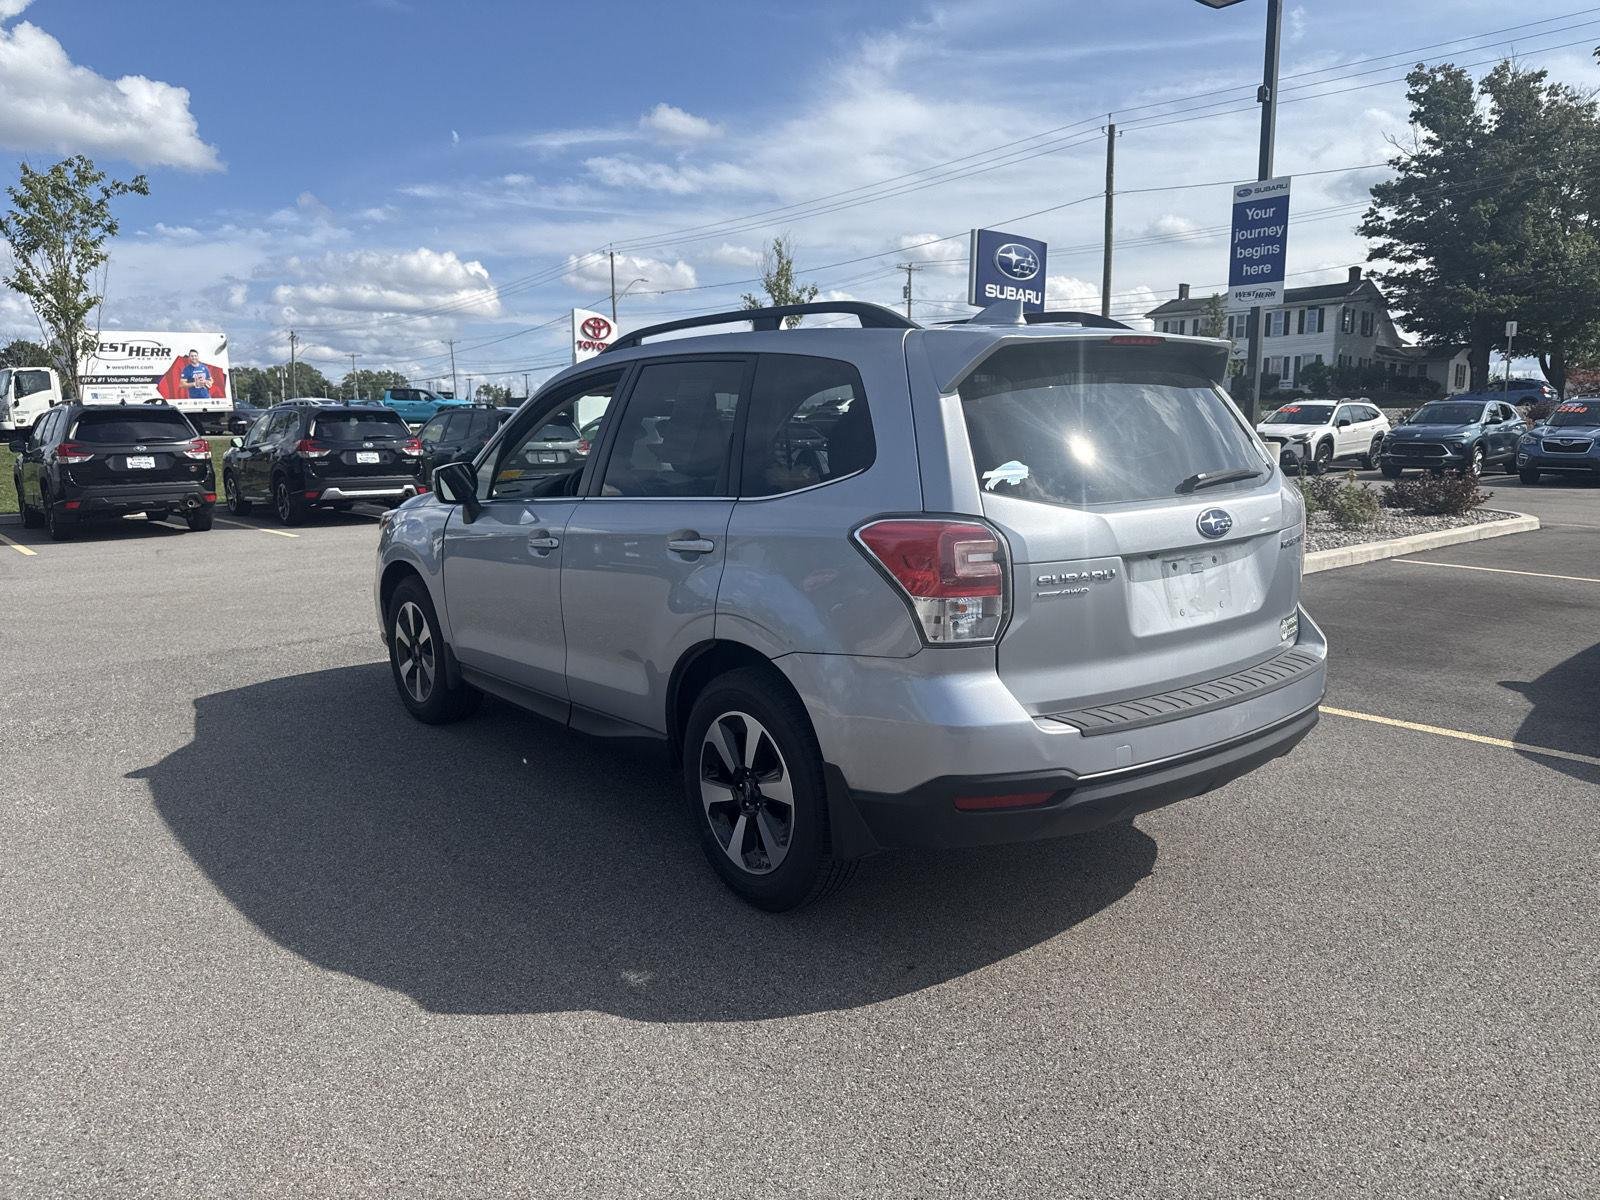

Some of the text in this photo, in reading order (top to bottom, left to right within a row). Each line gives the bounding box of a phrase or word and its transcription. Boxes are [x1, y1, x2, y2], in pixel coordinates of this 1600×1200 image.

[1254, 183, 1288, 193] SUBARU
[1246, 207, 1276, 220] Your
[1234, 225, 1285, 243] journey
[1236, 243, 1280, 259] begins
[1242, 263, 1272, 276] here
[985, 283, 1042, 305] SUBARU
[92, 342, 172, 357] EST HERR
[577, 340, 610, 351] TOYO
[1037, 568, 1116, 586] SUBARU
